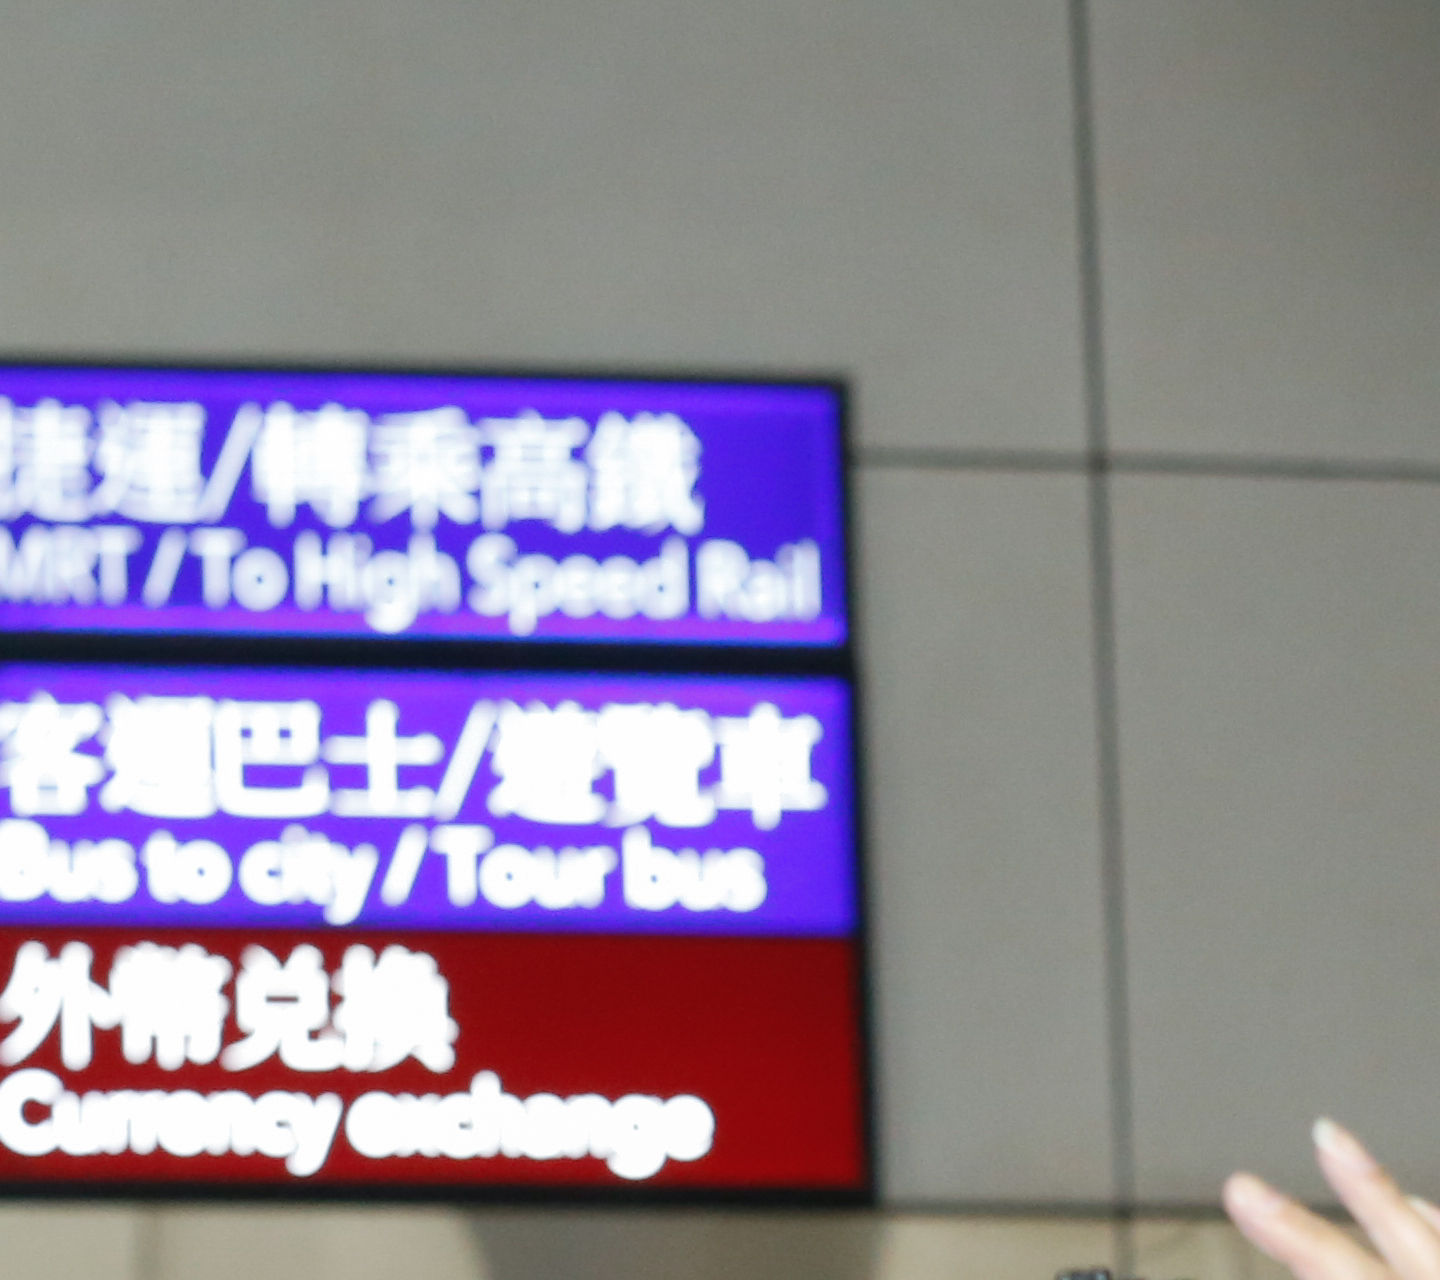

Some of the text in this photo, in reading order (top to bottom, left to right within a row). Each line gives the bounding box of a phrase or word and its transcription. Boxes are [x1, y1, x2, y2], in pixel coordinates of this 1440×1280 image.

[191, 529, 288, 610] To
[293, 532, 462, 635] High
[467, 533, 692, 637] Speed
[696, 540, 821, 625] Rail
[141, 830, 233, 905] to
[237, 825, 379, 925] city
[430, 825, 617, 910] Tour
[621, 824, 769, 911] bus
[345, 1071, 715, 1180] exchange
